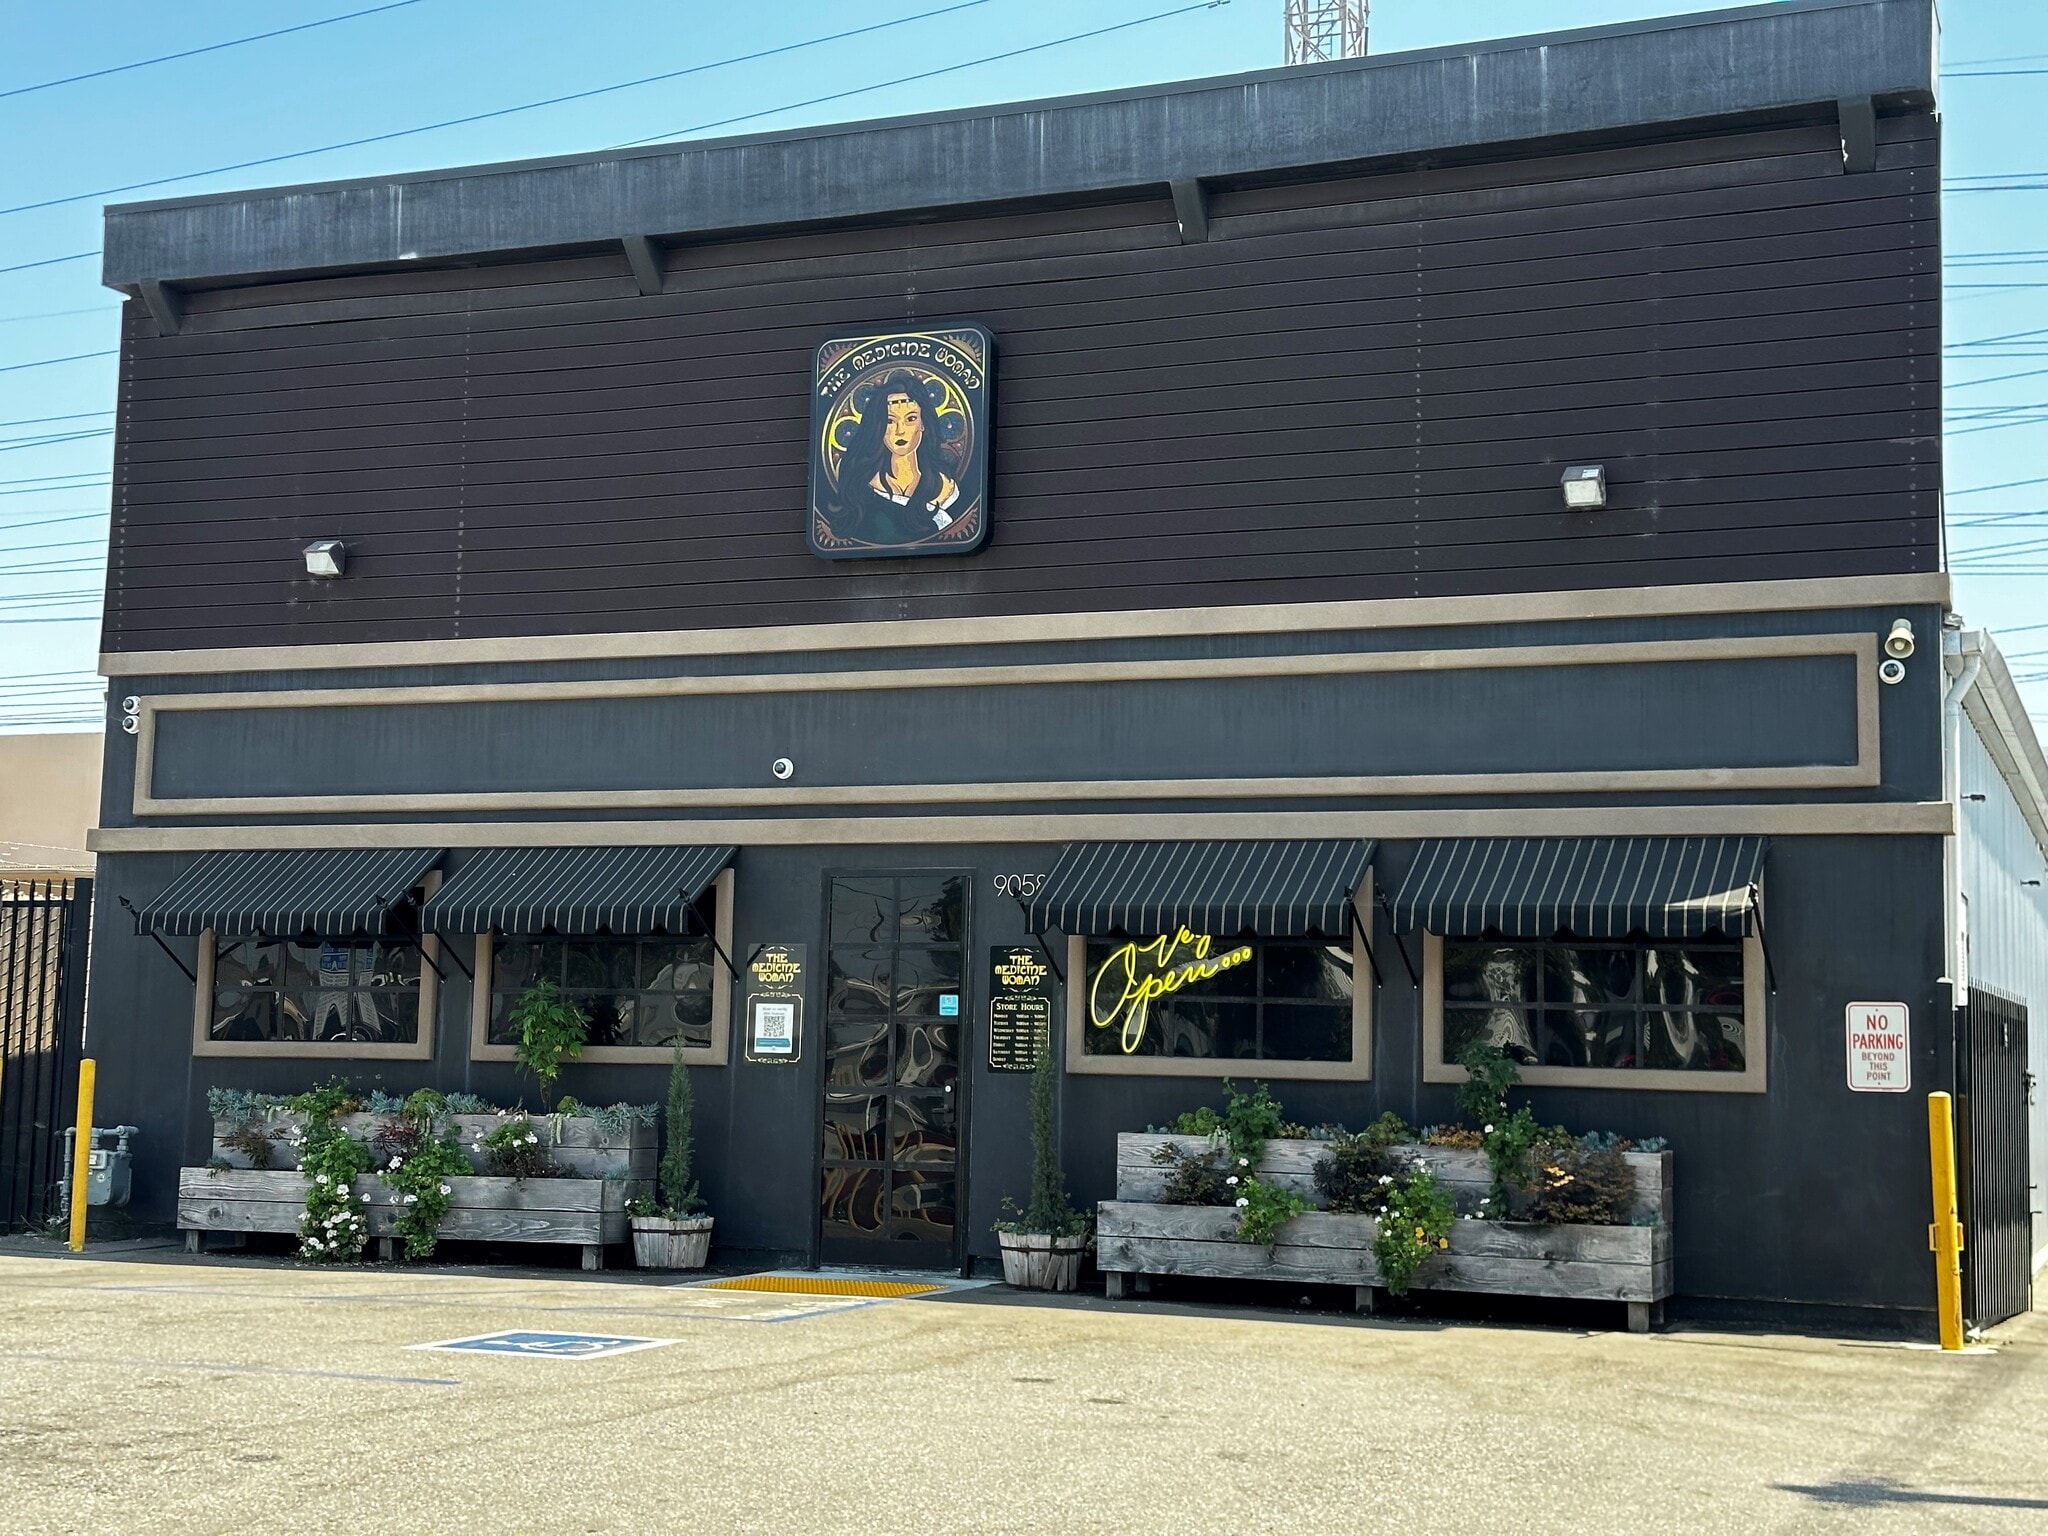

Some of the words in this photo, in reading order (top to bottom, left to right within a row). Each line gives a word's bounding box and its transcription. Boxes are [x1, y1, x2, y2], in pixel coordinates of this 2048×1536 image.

[820, 367, 851, 398] THE
[852, 341, 931, 371] MEDICINE
[934, 347, 981, 390] WOMAN
[765, 953, 789, 963] THE
[1009, 955, 1034, 965] THE
[751, 963, 802, 973] MEDICINE
[994, 965, 1048, 976] MEDICINE
[758, 972, 795, 983] WOMAN
[1001, 975, 1041, 986] WOMAN
[1867, 1015, 1888, 1030] NO
[1852, 1033, 1904, 1050] PARKING
[1861, 1052, 1895, 1061] BEYOND
[1869, 1062, 1888, 1071] THIS
[1866, 1071, 1892, 1081] POINT
